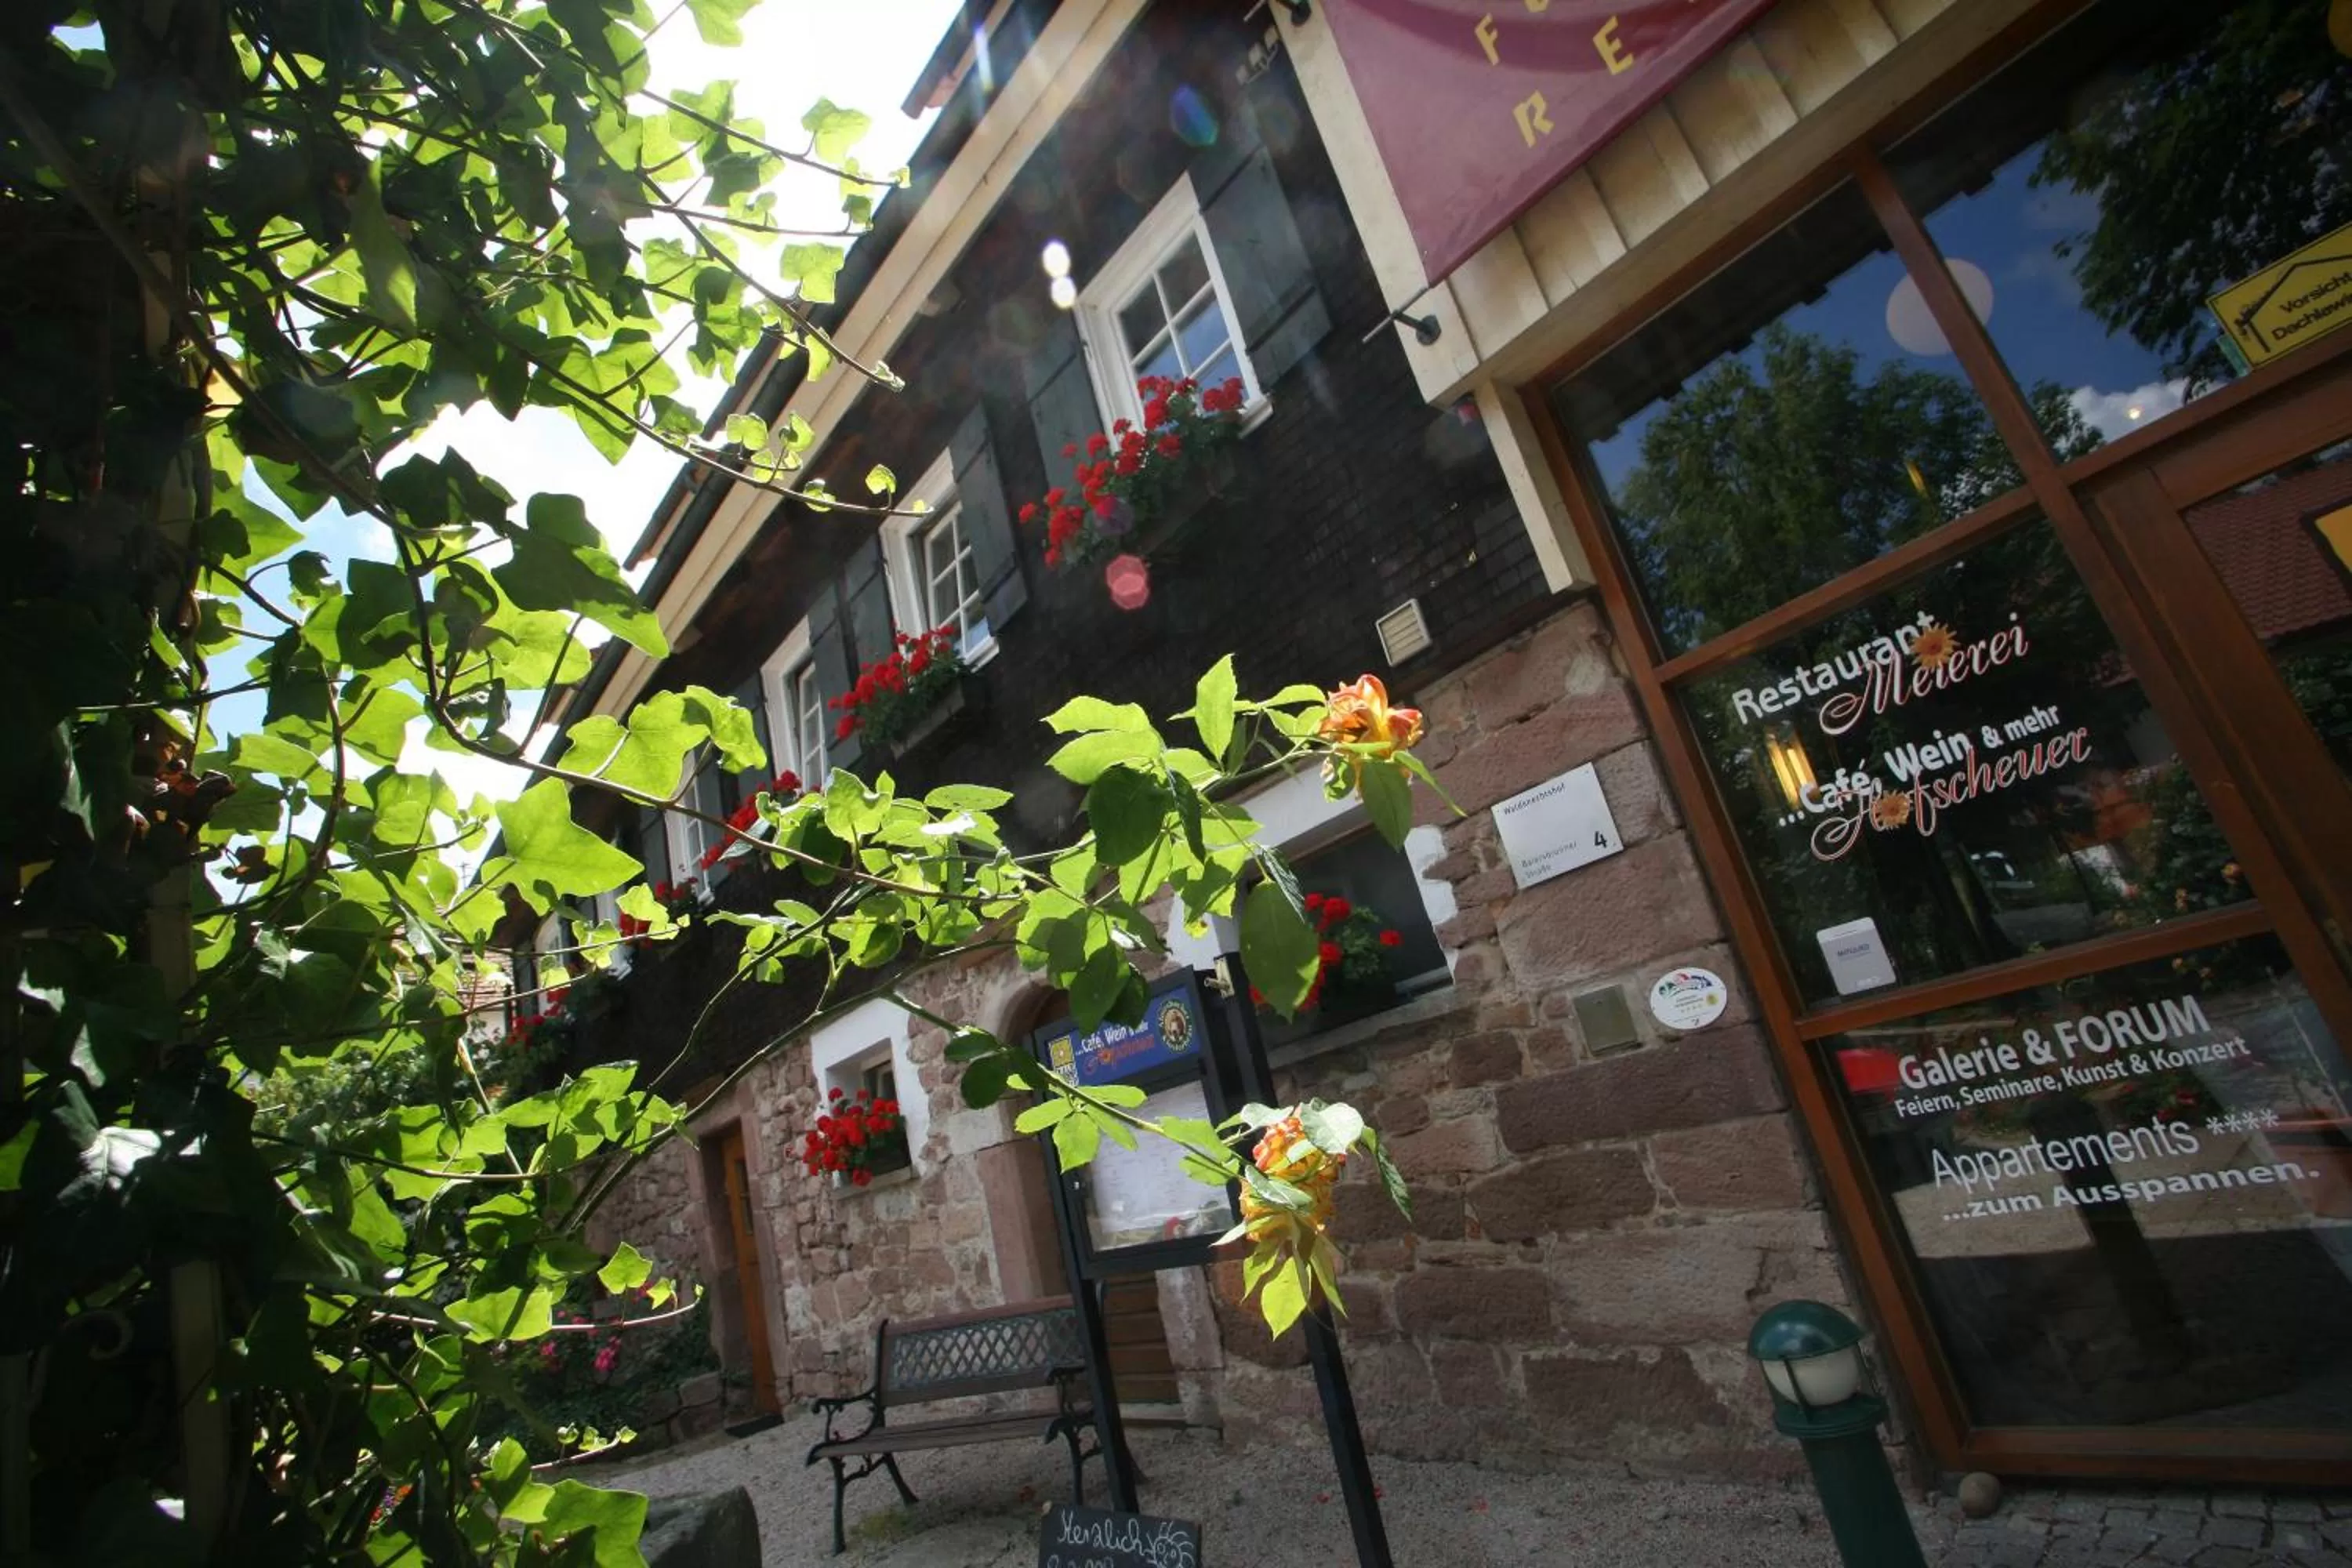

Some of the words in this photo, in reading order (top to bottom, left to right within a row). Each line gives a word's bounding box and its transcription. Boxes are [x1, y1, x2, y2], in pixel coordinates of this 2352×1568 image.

[2279, 271, 2352, 313] Vorsicht
[1732, 610, 1935, 725] Restaurant
[1819, 612, 2029, 735] Meierei
[1884, 729, 1976, 782] Wein
[1981, 725, 2004, 749] &
[2003, 706, 2060, 741] mehr
[1810, 727, 2092, 861] Hfscheuer
[1594, 830, 1607, 849] 4
[1894, 1095, 1962, 1118] Feiern,
[1960, 1072, 2063, 1105] Seminare,
[2060, 1060, 2129, 1088] Kunst
[2129, 1054, 2151, 1074] &
[2151, 1035, 2251, 1071] Konzert
[1898, 1036, 2021, 1090] Galerie
[2022, 1028, 2058, 1066] &
[2054, 994, 2211, 1058] FORUM
[1931, 1116, 2201, 1195] Appartements
[1944, 1193, 2043, 1221] ...zum
[2053, 1162, 2321, 1208] Ausspannen.
